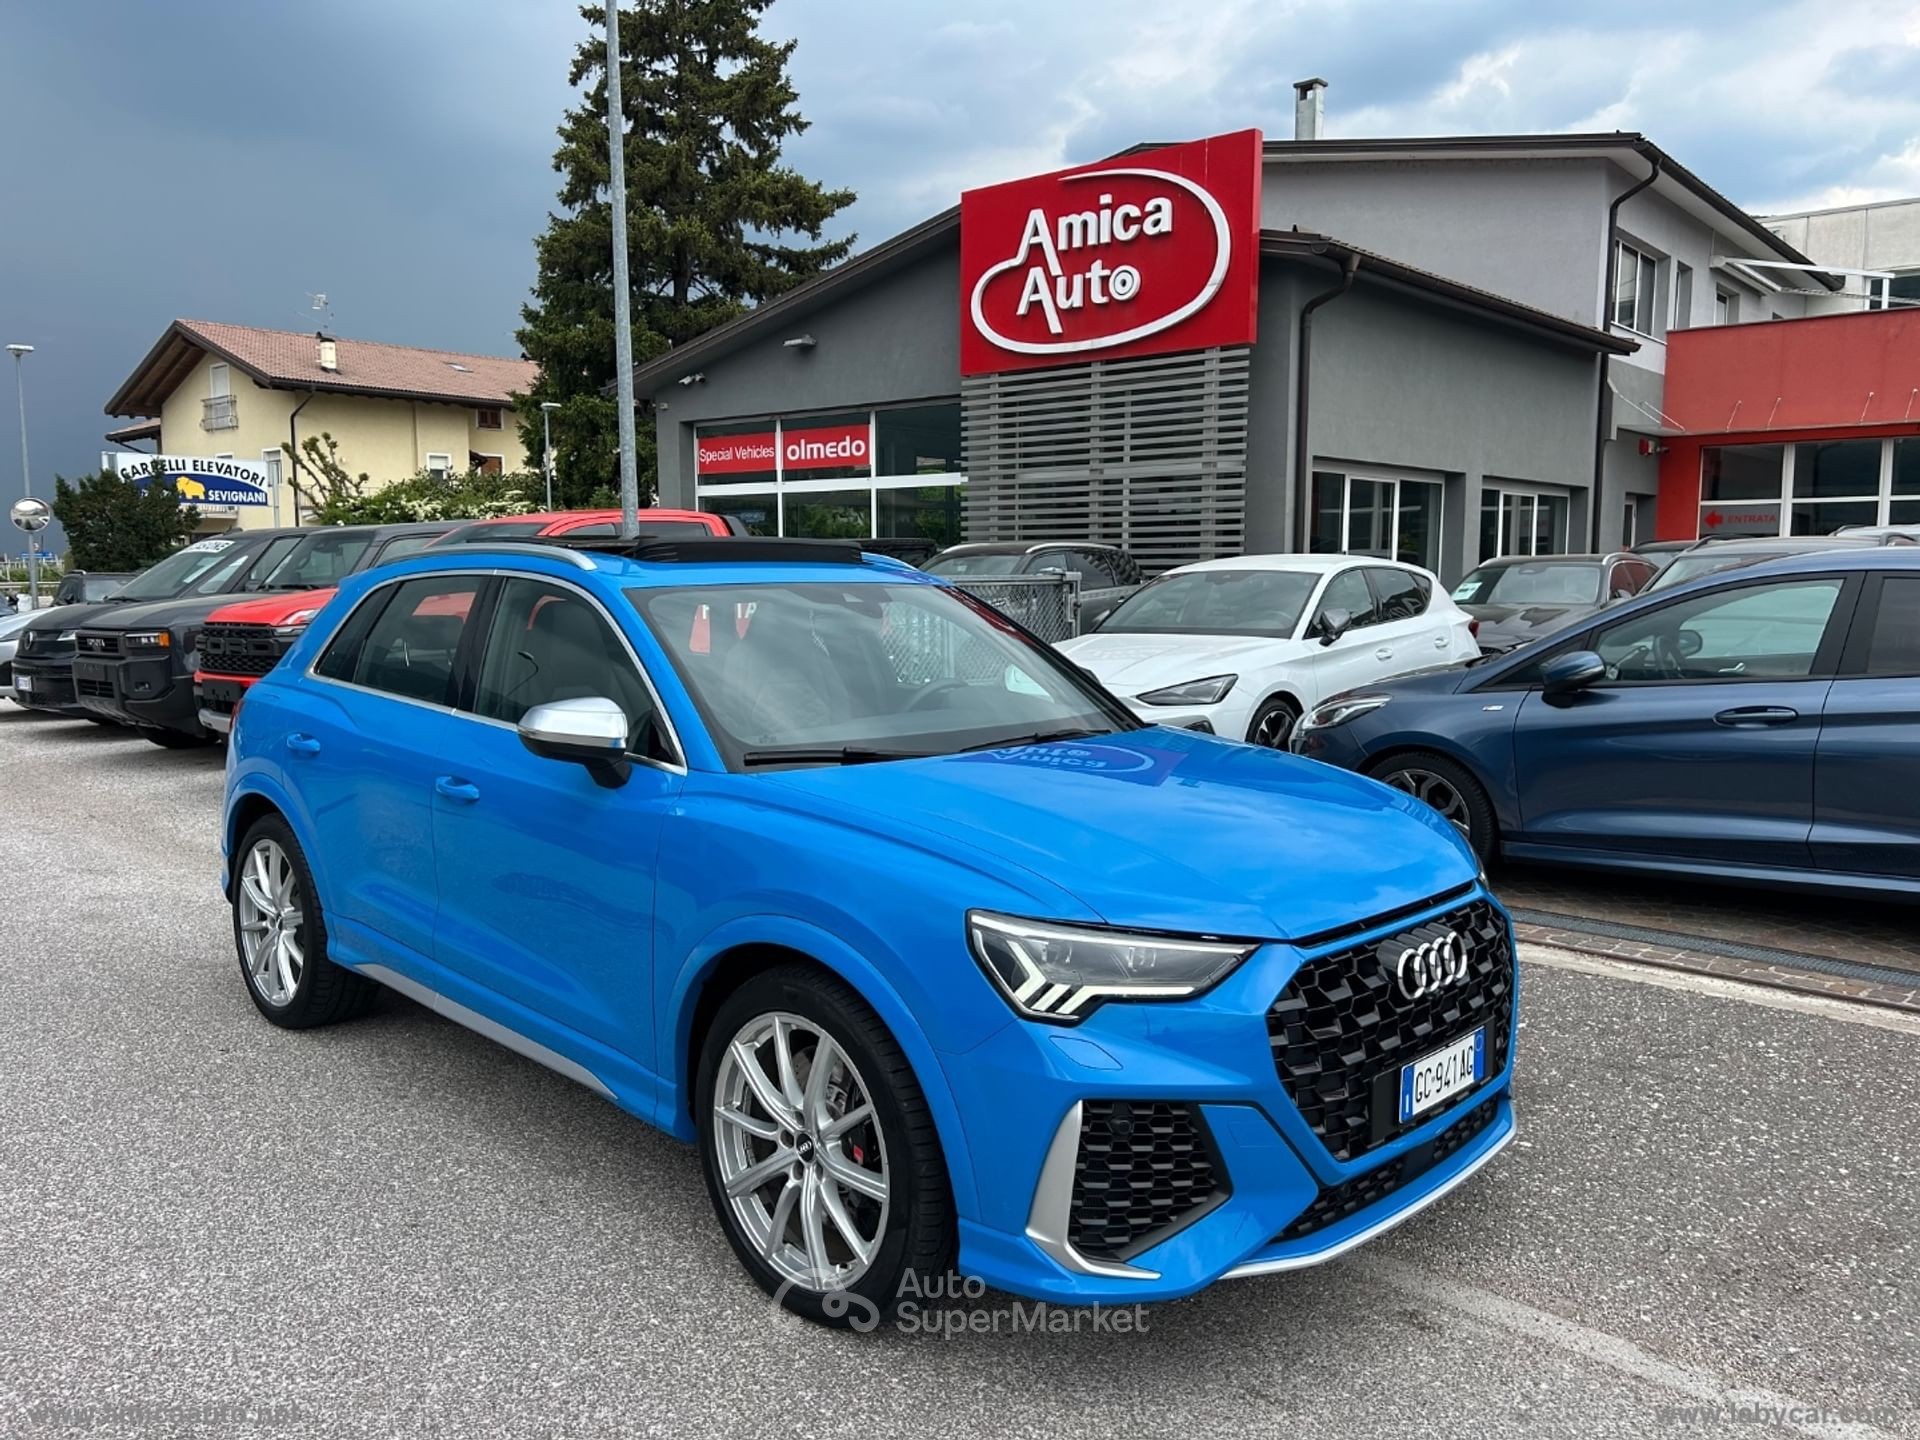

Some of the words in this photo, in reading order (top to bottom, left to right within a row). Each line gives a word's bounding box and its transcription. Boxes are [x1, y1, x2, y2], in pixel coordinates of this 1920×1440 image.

[1016, 193, 1173, 276] Amica
[1016, 259, 1141, 334] Auto
[699, 447, 733, 463] Special
[735, 445, 775, 460] Vehicles
[787, 435, 866, 461] olmedo
[192, 459, 266, 487] ELEVATORI
[208, 489, 267, 503] SEVIGNANI
[1727, 514, 1778, 524] ENTRATA
